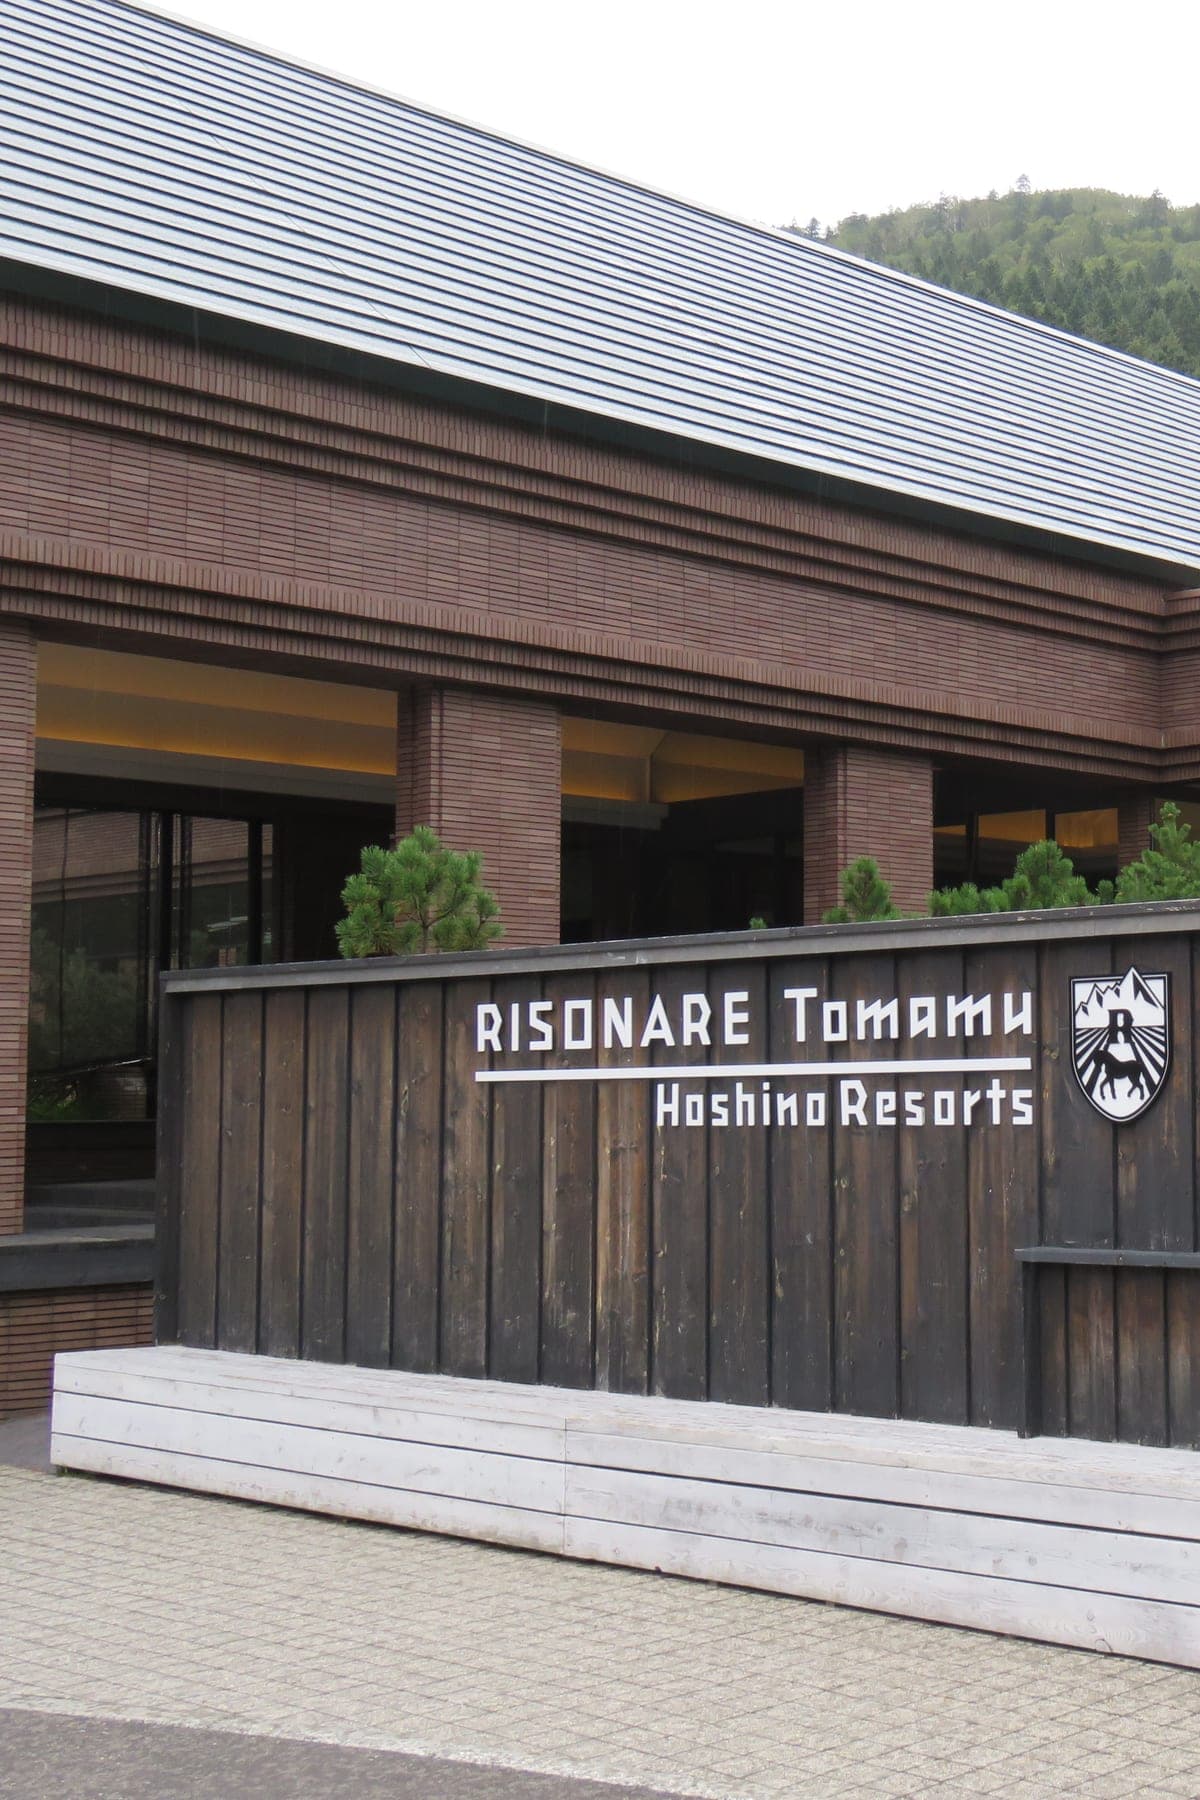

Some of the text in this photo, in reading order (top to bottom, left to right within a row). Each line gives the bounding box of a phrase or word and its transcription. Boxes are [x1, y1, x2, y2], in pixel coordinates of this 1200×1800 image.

[477, 987, 1033, 1053] RISONARE Tomamu
[1108, 1008, 1134, 1044] R
[656, 1078, 1034, 1133] Hoshino Resorts
